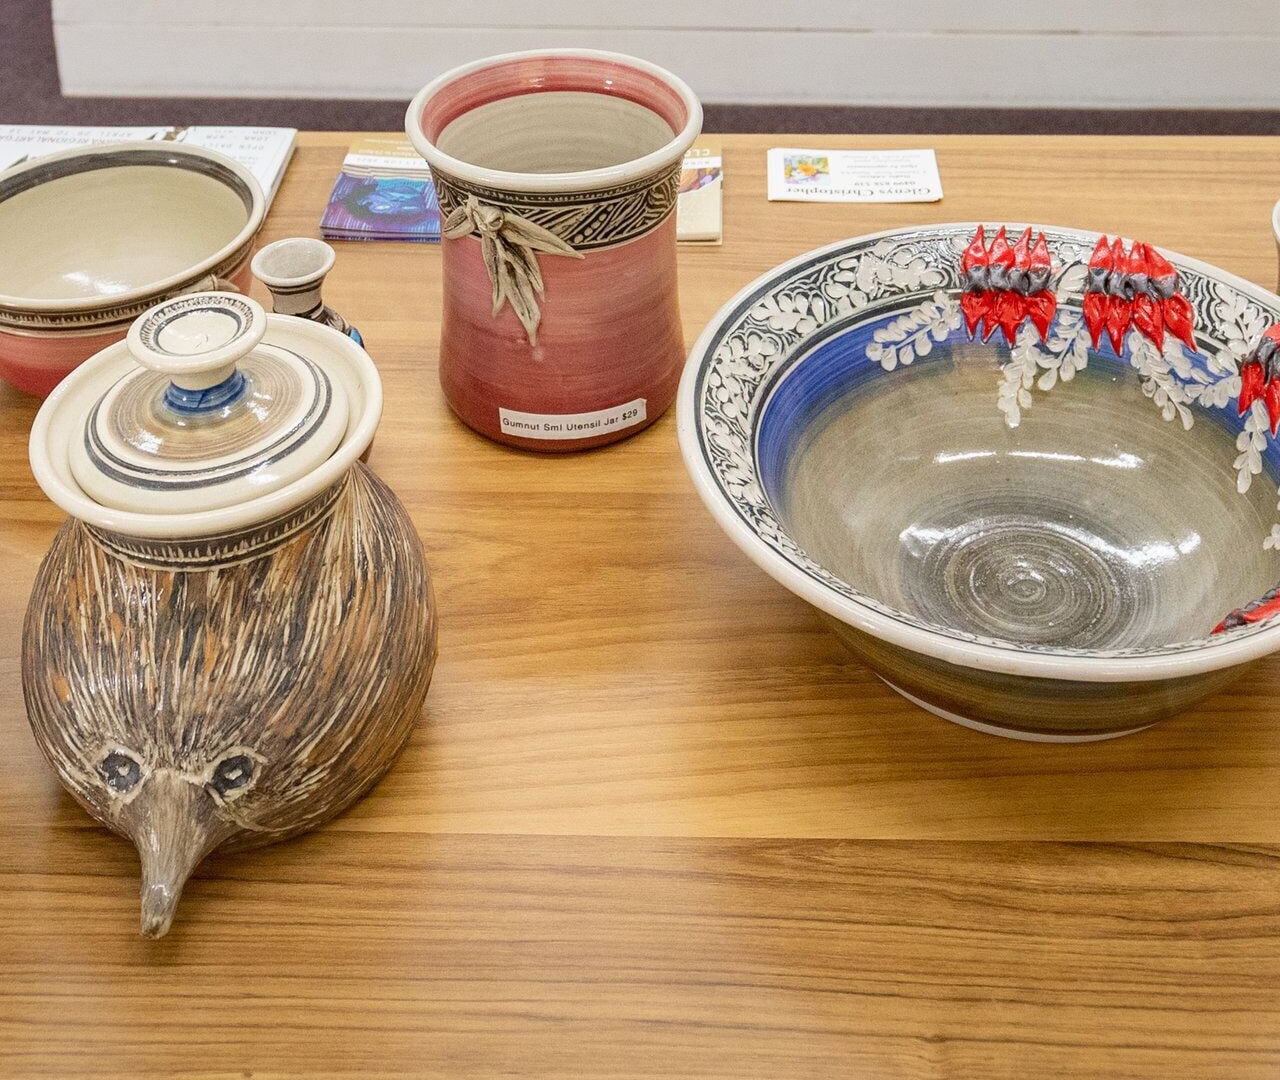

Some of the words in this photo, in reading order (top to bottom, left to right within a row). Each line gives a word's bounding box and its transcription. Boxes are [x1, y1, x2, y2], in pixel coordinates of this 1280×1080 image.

[785, 186, 874, 197] Christopher
[878, 187, 931, 196] Glenys
[502, 417, 540, 431] Gumnut
[543, 423, 563, 432] Sml
[566, 419, 601, 432] Utensil
[604, 416, 619, 426] Jar
[621, 408, 638, 421] $29
